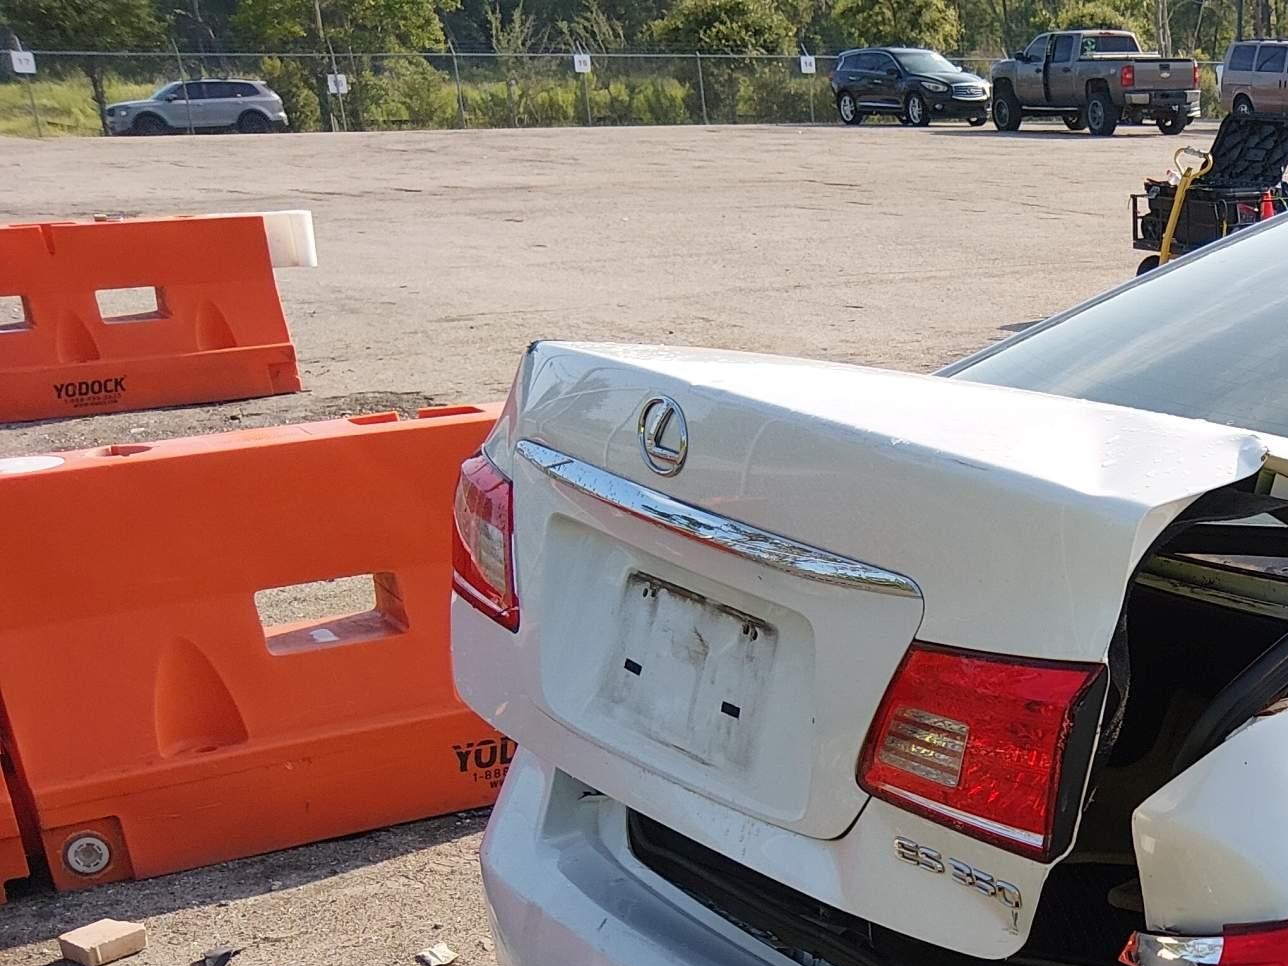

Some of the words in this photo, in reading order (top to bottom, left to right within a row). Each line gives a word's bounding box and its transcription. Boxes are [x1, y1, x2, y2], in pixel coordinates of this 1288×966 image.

[53, 376, 126, 399] YODOCK
[893, 836, 945, 873] ES
[948, 857, 1022, 909] 350
